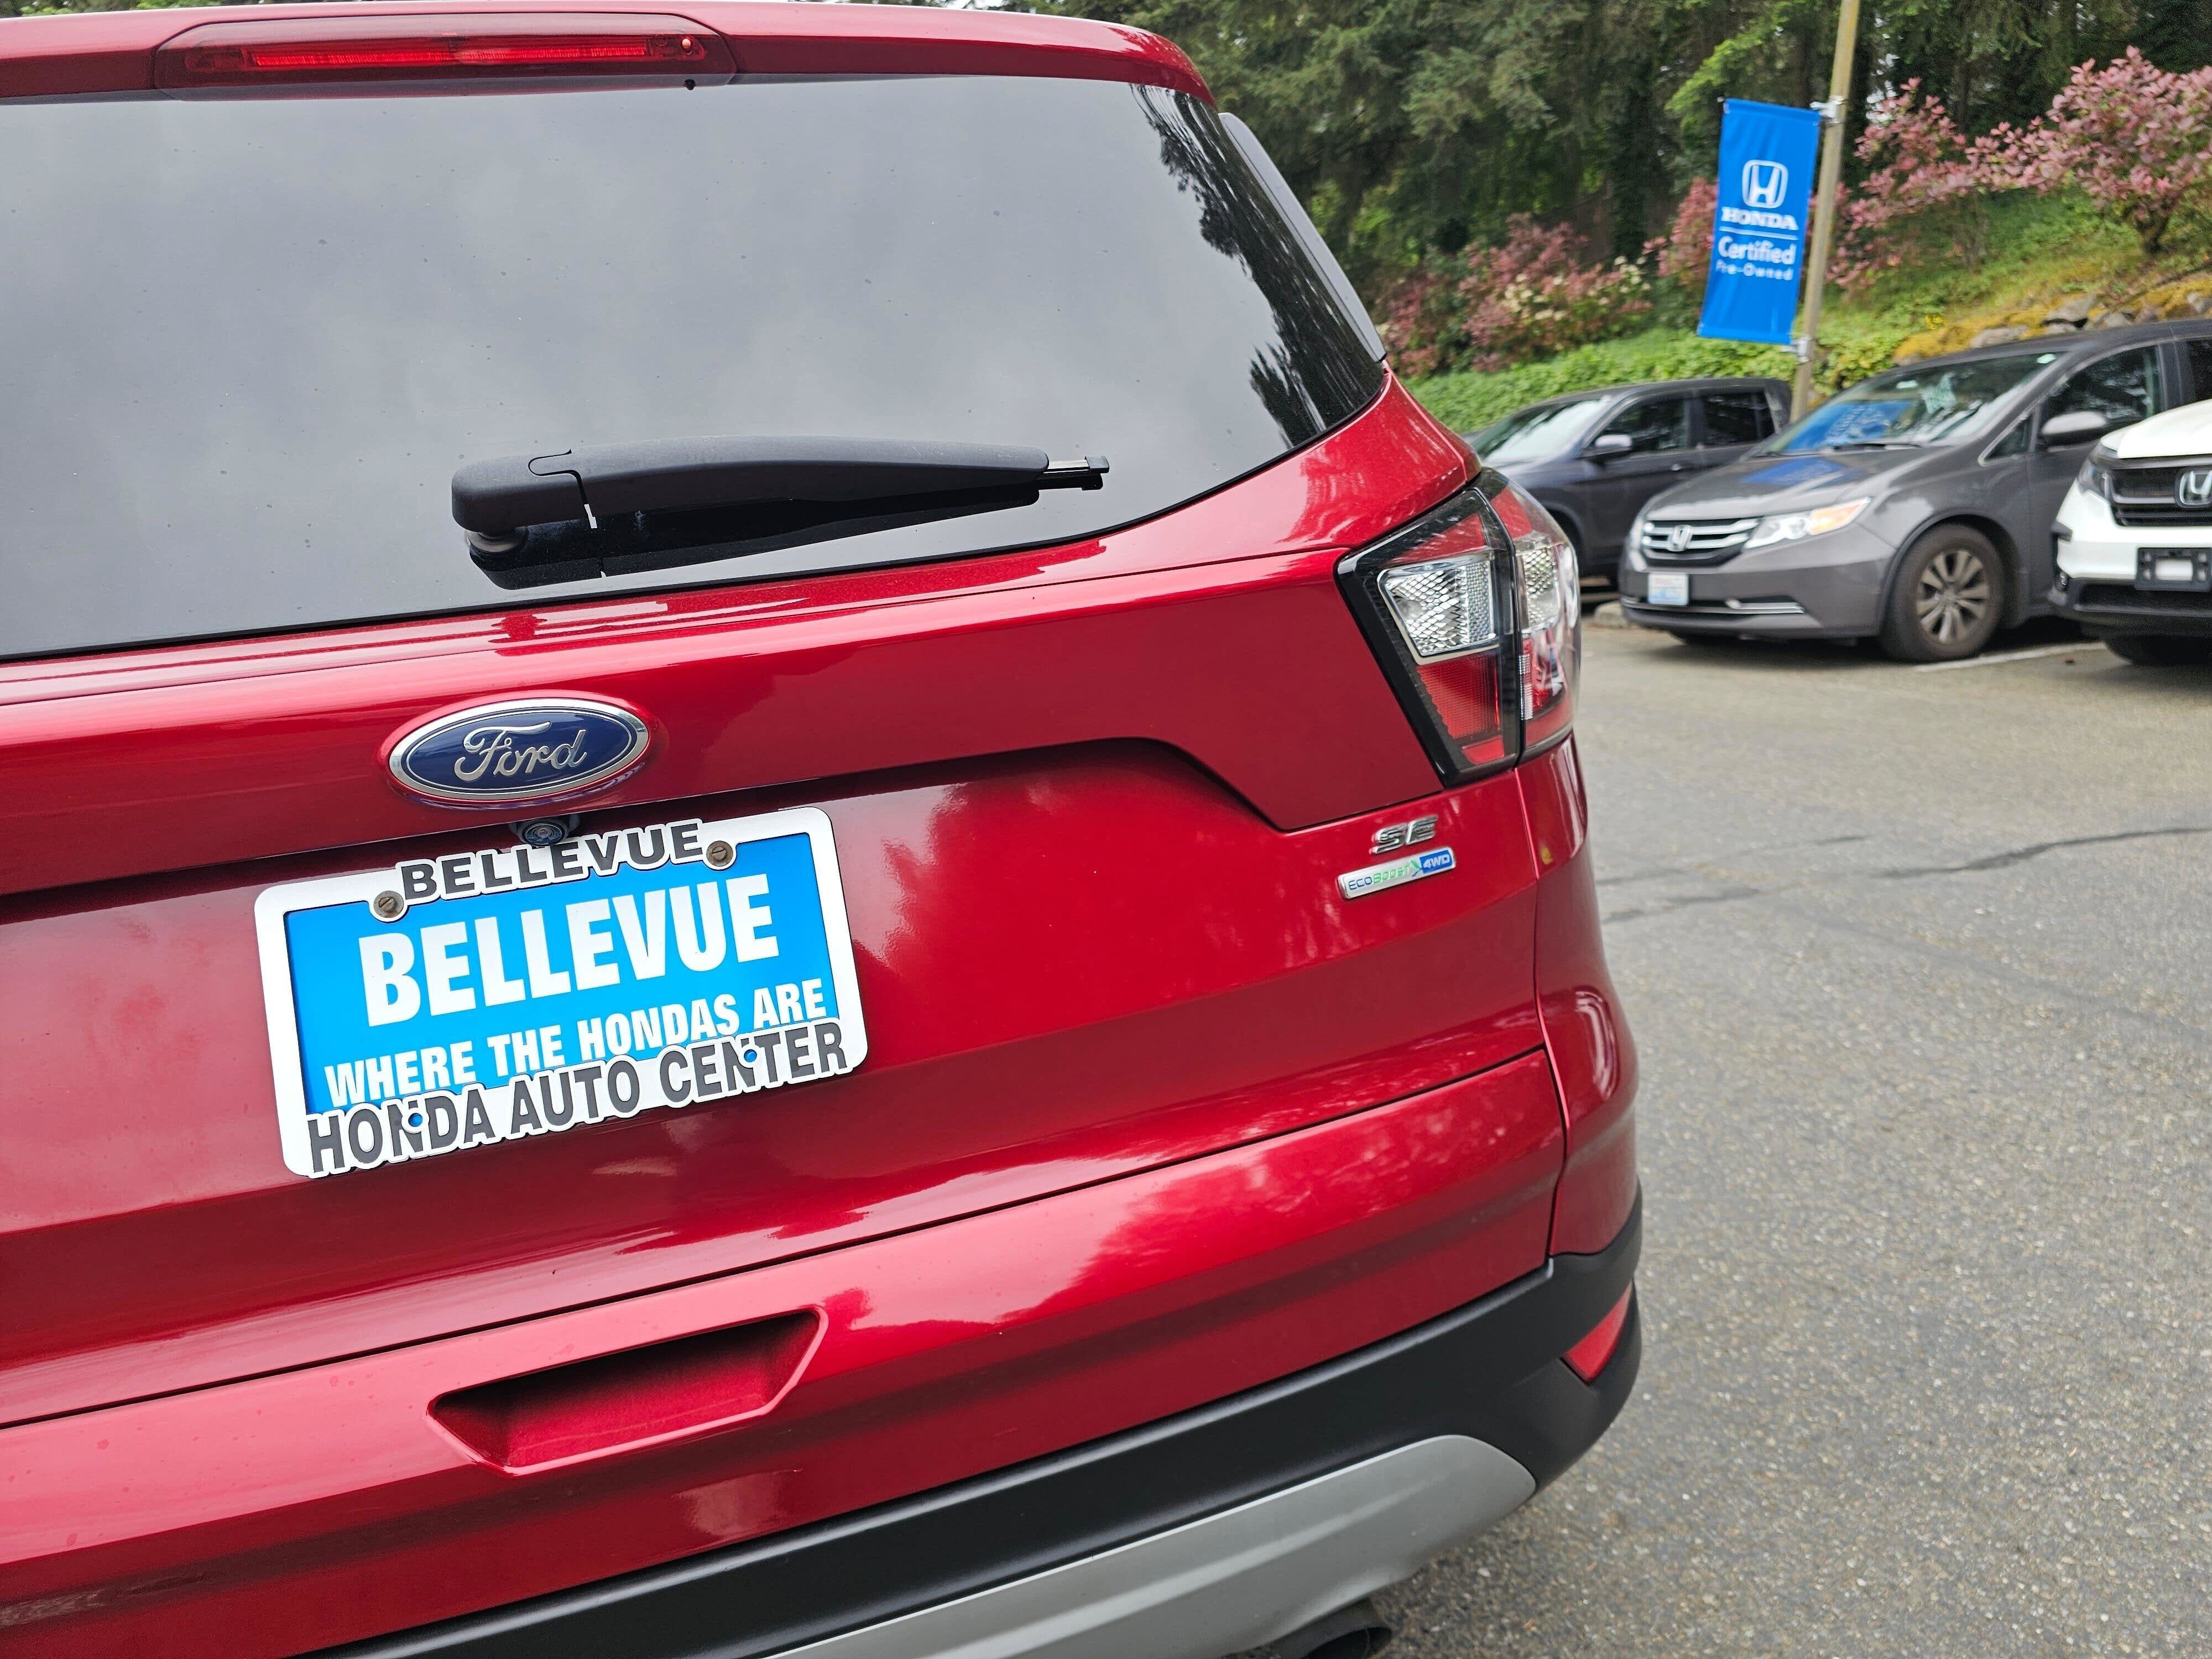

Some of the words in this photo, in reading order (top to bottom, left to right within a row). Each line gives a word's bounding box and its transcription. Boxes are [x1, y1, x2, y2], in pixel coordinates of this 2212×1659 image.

[1721, 207, 1798, 231] HONDA
[1719, 236, 1796, 265] Certified
[454, 721, 587, 781] Ford
[401, 823, 704, 900] BELLEVUE
[1371, 815, 1438, 854] SE
[1423, 854, 1451, 869] 4WD
[358, 874, 779, 1027] BELLEVUE
[324, 1041, 477, 1108] WHERE
[487, 1025, 566, 1077] THE
[577, 994, 740, 1063] HONDAS
[753, 978, 827, 1027] ARE
[307, 1089, 495, 1173] HONDA
[510, 1060, 640, 1135] AUTO
[659, 1022, 848, 1103] CENTER
